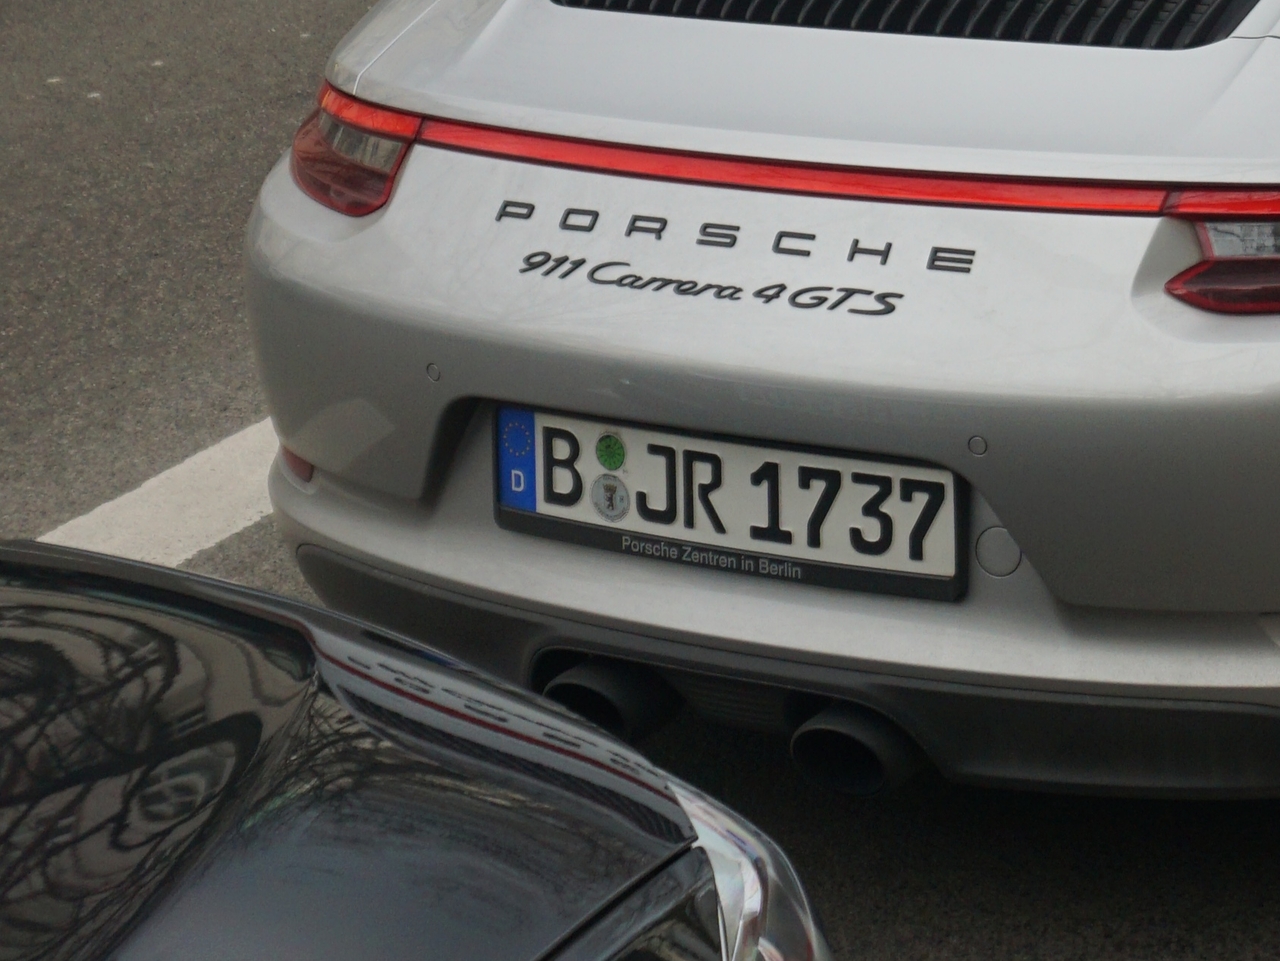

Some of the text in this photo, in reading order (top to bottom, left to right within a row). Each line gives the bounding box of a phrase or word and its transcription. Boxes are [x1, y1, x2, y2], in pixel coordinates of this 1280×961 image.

[495, 200, 976, 273] PORSCHE
[518, 251, 587, 279] 911
[586, 261, 743, 301] Carrera
[511, 470, 525, 492] D
[542, 426, 584, 508] B
[635, 443, 727, 534] JR
[749, 461, 946, 561] 1737
[622, 536, 802, 580] Porsche Zentren in Berlin
